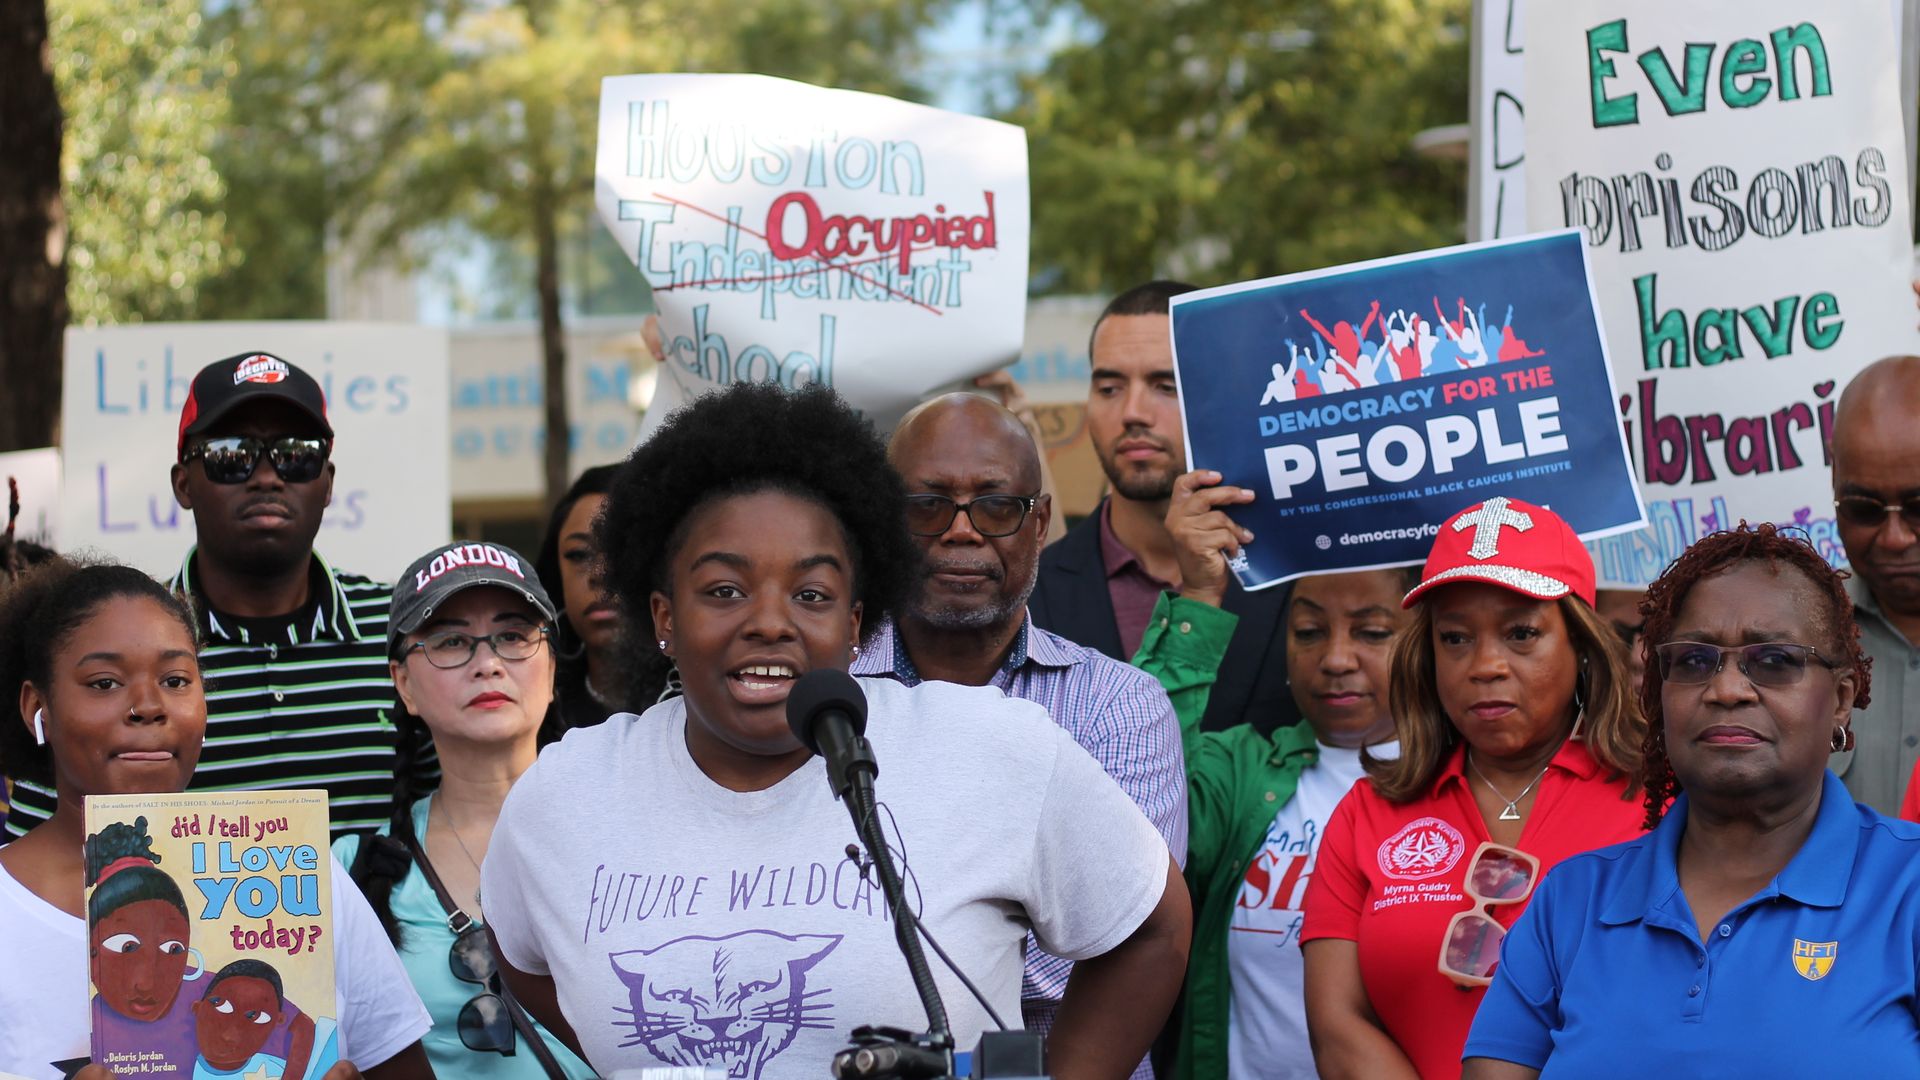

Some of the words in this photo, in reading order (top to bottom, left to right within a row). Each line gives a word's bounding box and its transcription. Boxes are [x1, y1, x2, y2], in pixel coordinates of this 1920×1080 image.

[1586, 18, 1833, 129] Even
[626, 99, 924, 197] Houston
[1560, 147, 1891, 253] prisons
[765, 190, 998, 276] Occupied
[659, 303, 836, 393] chool
[1633, 273, 1845, 371] have
[95, 345, 411, 414] Libies
[1259, 387, 1436, 436] DEMOCRACY
[1443, 376, 1498, 404] FOR
[1501, 365, 1555, 393] THE
[1264, 396, 1569, 500] PEOPLE
[1619, 377, 1836, 485] ibrari
[1280, 507, 1296, 516] BY
[1299, 504, 1322, 513] THE
[1324, 489, 1422, 510] CONGRESSIONAL
[1425, 482, 1464, 496] BLACK
[1468, 474, 1513, 489] CAUCUS
[1516, 461, 1572, 481] INSTITUTE
[1339, 523, 1442, 546] democracyfo
[416, 544, 525, 593] LONDON
[171, 813, 201, 838] did
[219, 815, 250, 837] tell
[254, 817, 289, 842] you
[192, 841, 206, 874] I
[218, 841, 318, 873] Love
[193, 874, 322, 920] YOU
[729, 854, 888, 922] WILDCA
[1374, 895, 1407, 911] District
[1409, 894, 1420, 903] IX
[1423, 893, 1463, 902] Trustee
[1384, 884, 1415, 896] Myrna
[1418, 882, 1451, 893] Guidry
[230, 918, 323, 955] today?
[1795, 941, 1836, 957] HFT
[109, 1052, 137, 1062] Deloris
[137, 1051, 164, 1062] Jordan
[114, 1063, 139, 1075] Roslyn
[141, 1063, 150, 1072] M.
[150, 1062, 177, 1073] Jordan
